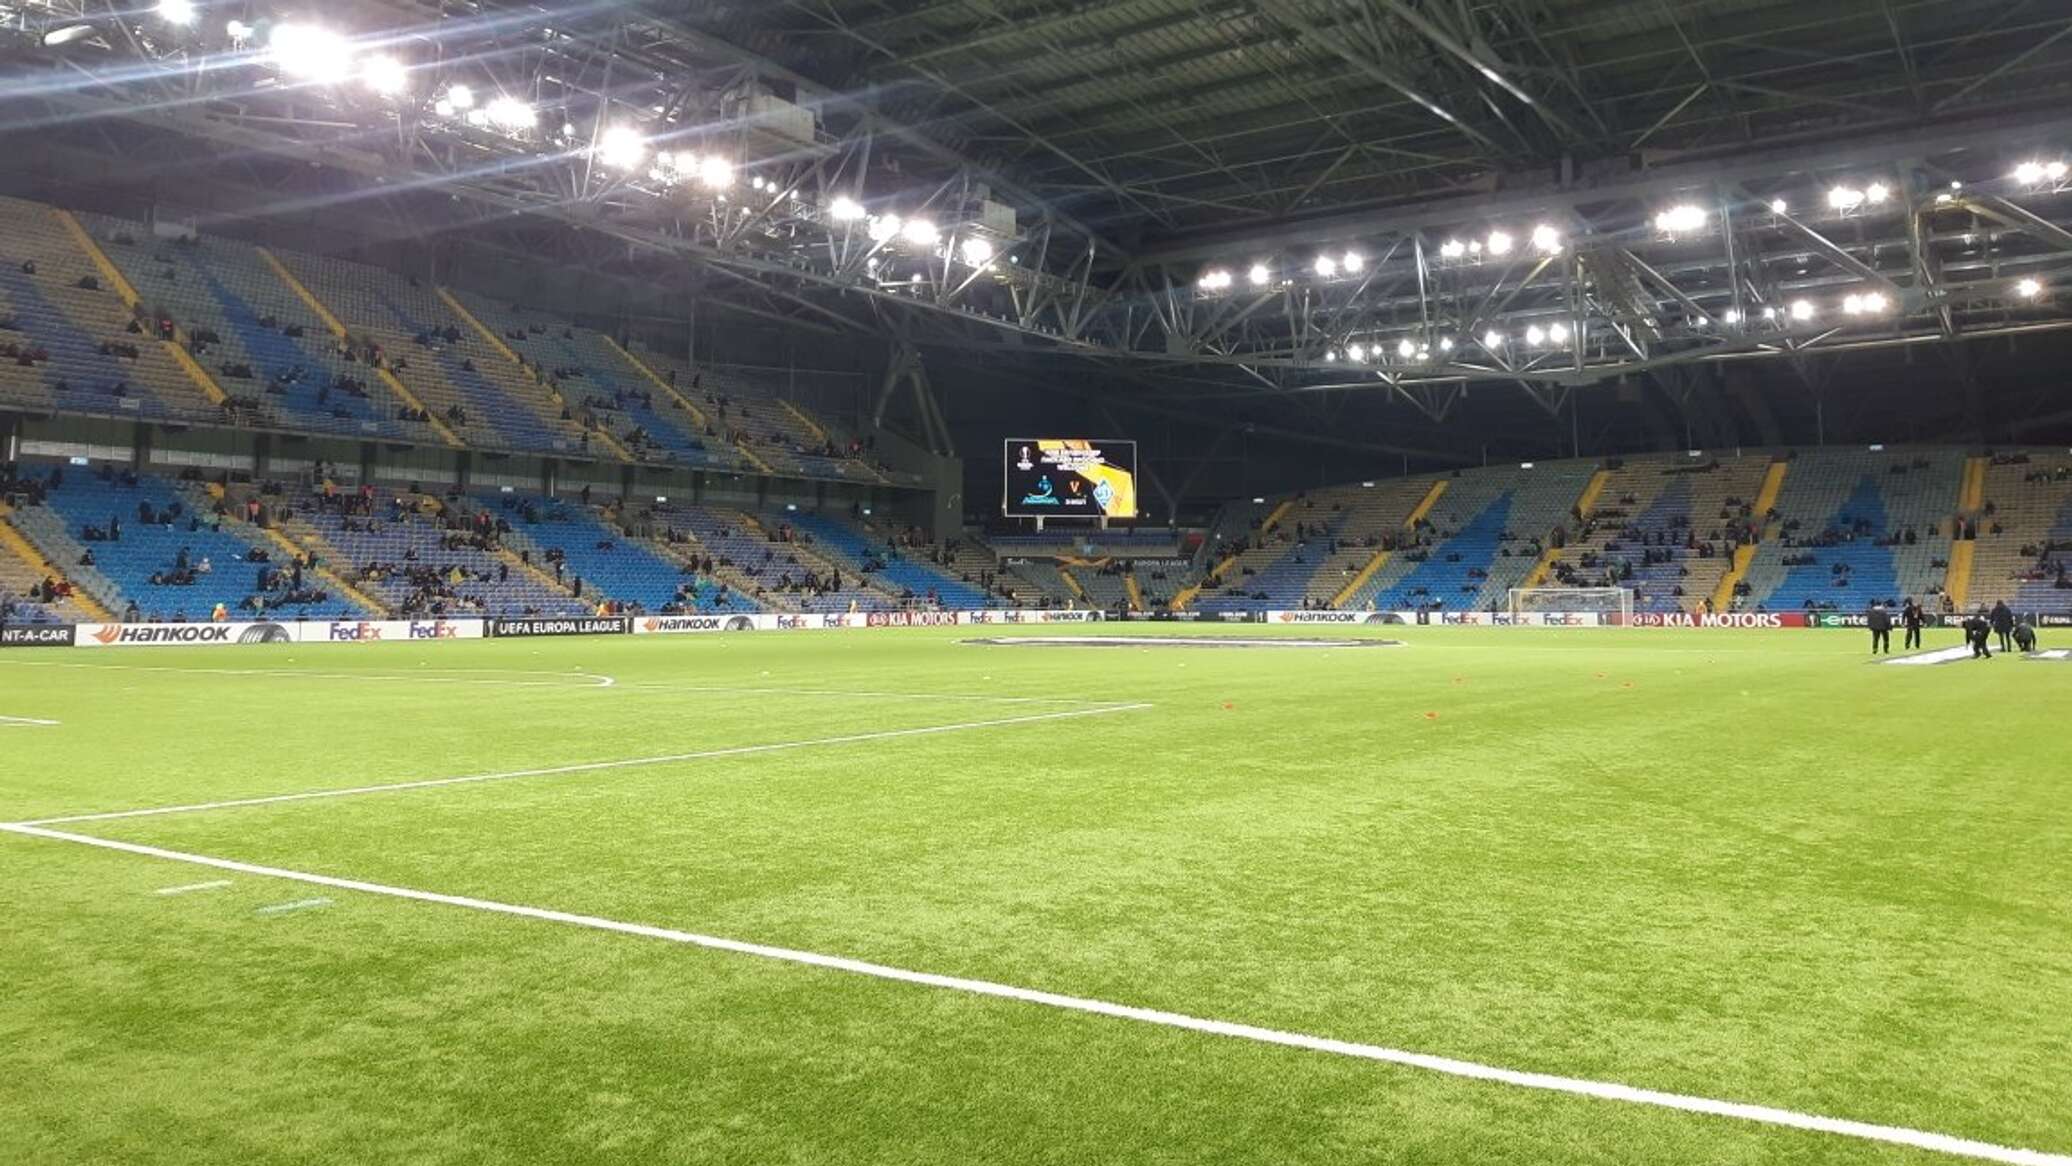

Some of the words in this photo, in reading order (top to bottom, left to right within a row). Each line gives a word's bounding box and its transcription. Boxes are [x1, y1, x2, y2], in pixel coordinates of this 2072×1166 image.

[889, 612, 908, 625] KIA
[911, 611, 955, 625] MOTORS
[1441, 613, 1478, 625] FedEx
[1544, 613, 1583, 625] FedEx
[1664, 613, 1695, 627] KIA
[1700, 613, 1781, 627] MOTORS
[330, 622, 381, 640] FedEx
[410, 620, 456, 638] FedEx
[500, 622, 530, 634] UEFA
[533, 621, 577, 633] EUROPA
[580, 620, 620, 632] LEAGUE
[2, 629, 68, 641] NT-A-CAR
